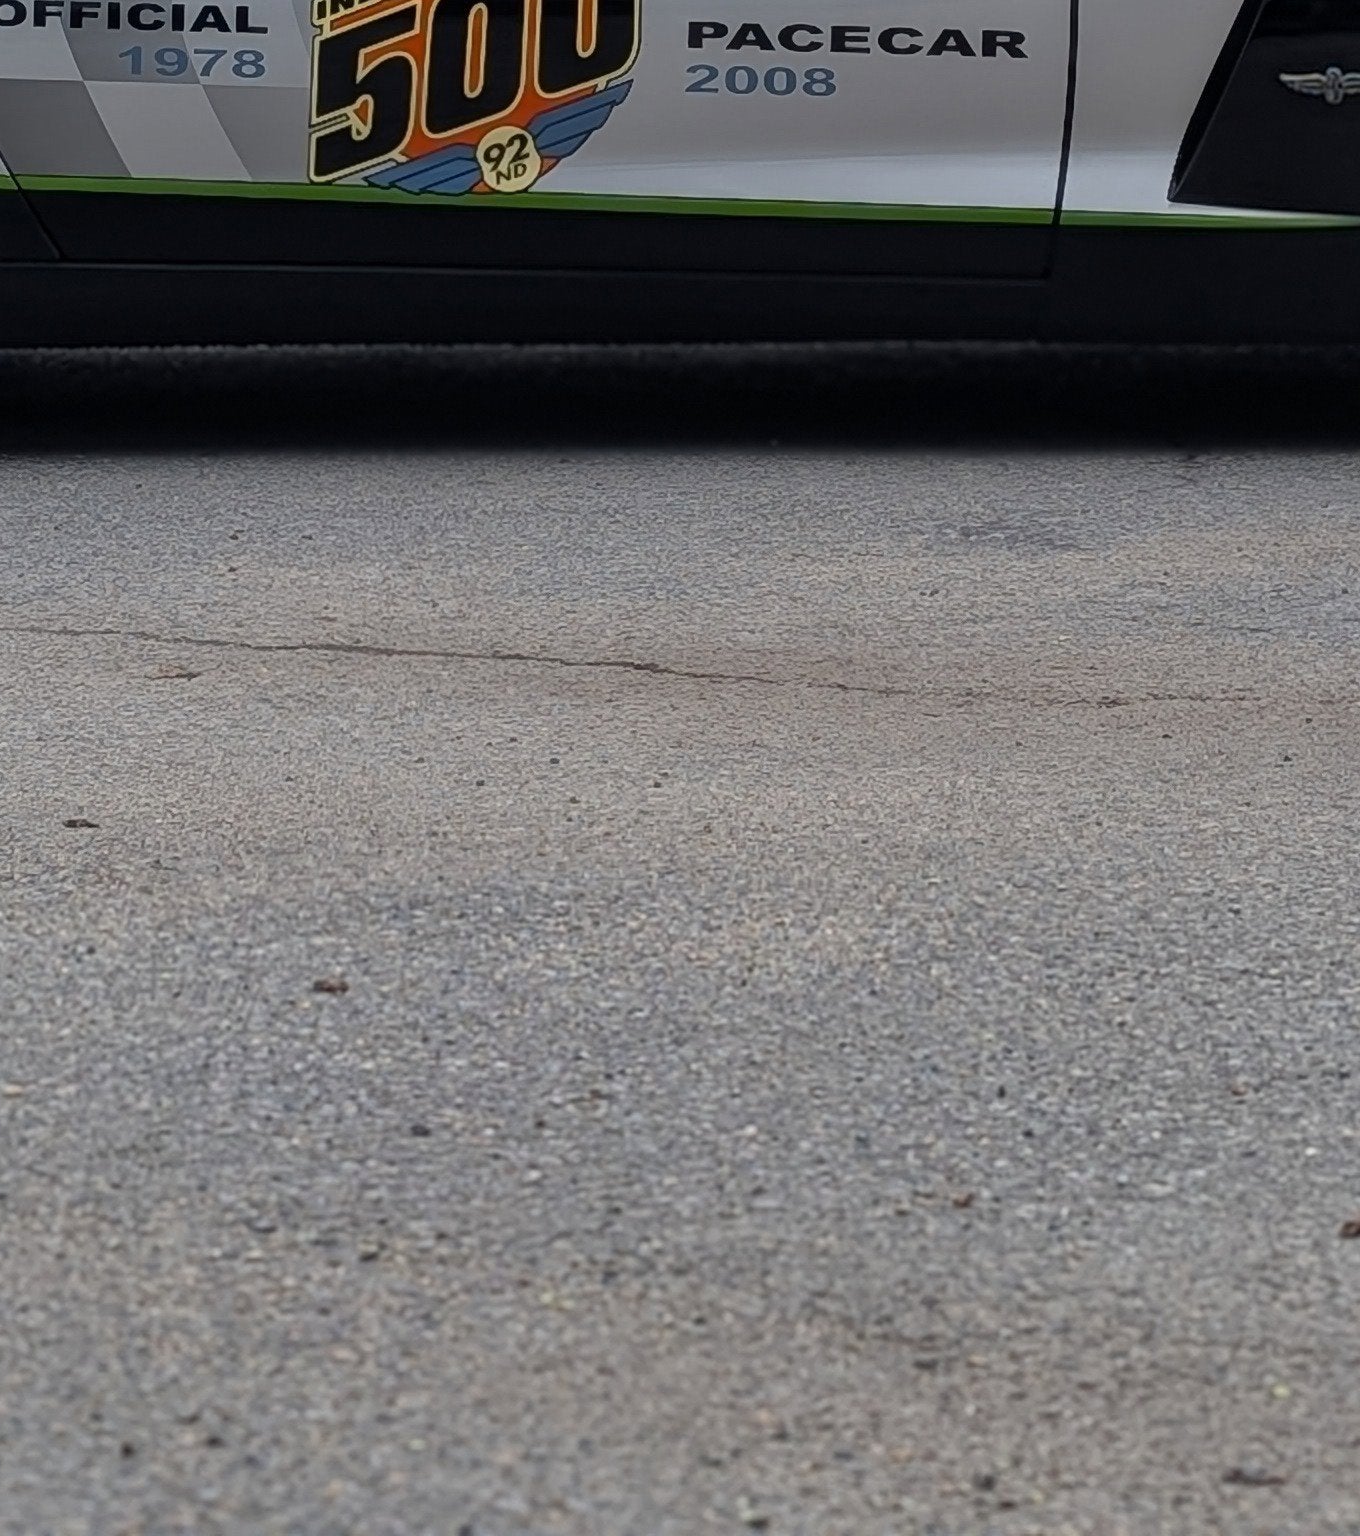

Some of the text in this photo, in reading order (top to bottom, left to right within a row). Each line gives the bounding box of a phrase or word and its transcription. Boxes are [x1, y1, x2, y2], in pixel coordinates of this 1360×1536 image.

[687, 21, 1029, 59] PACECAR
[118, 45, 266, 78] 1978
[685, 64, 837, 97] 2008
[483, 133, 530, 172] 92
[496, 162, 527, 185] ND
